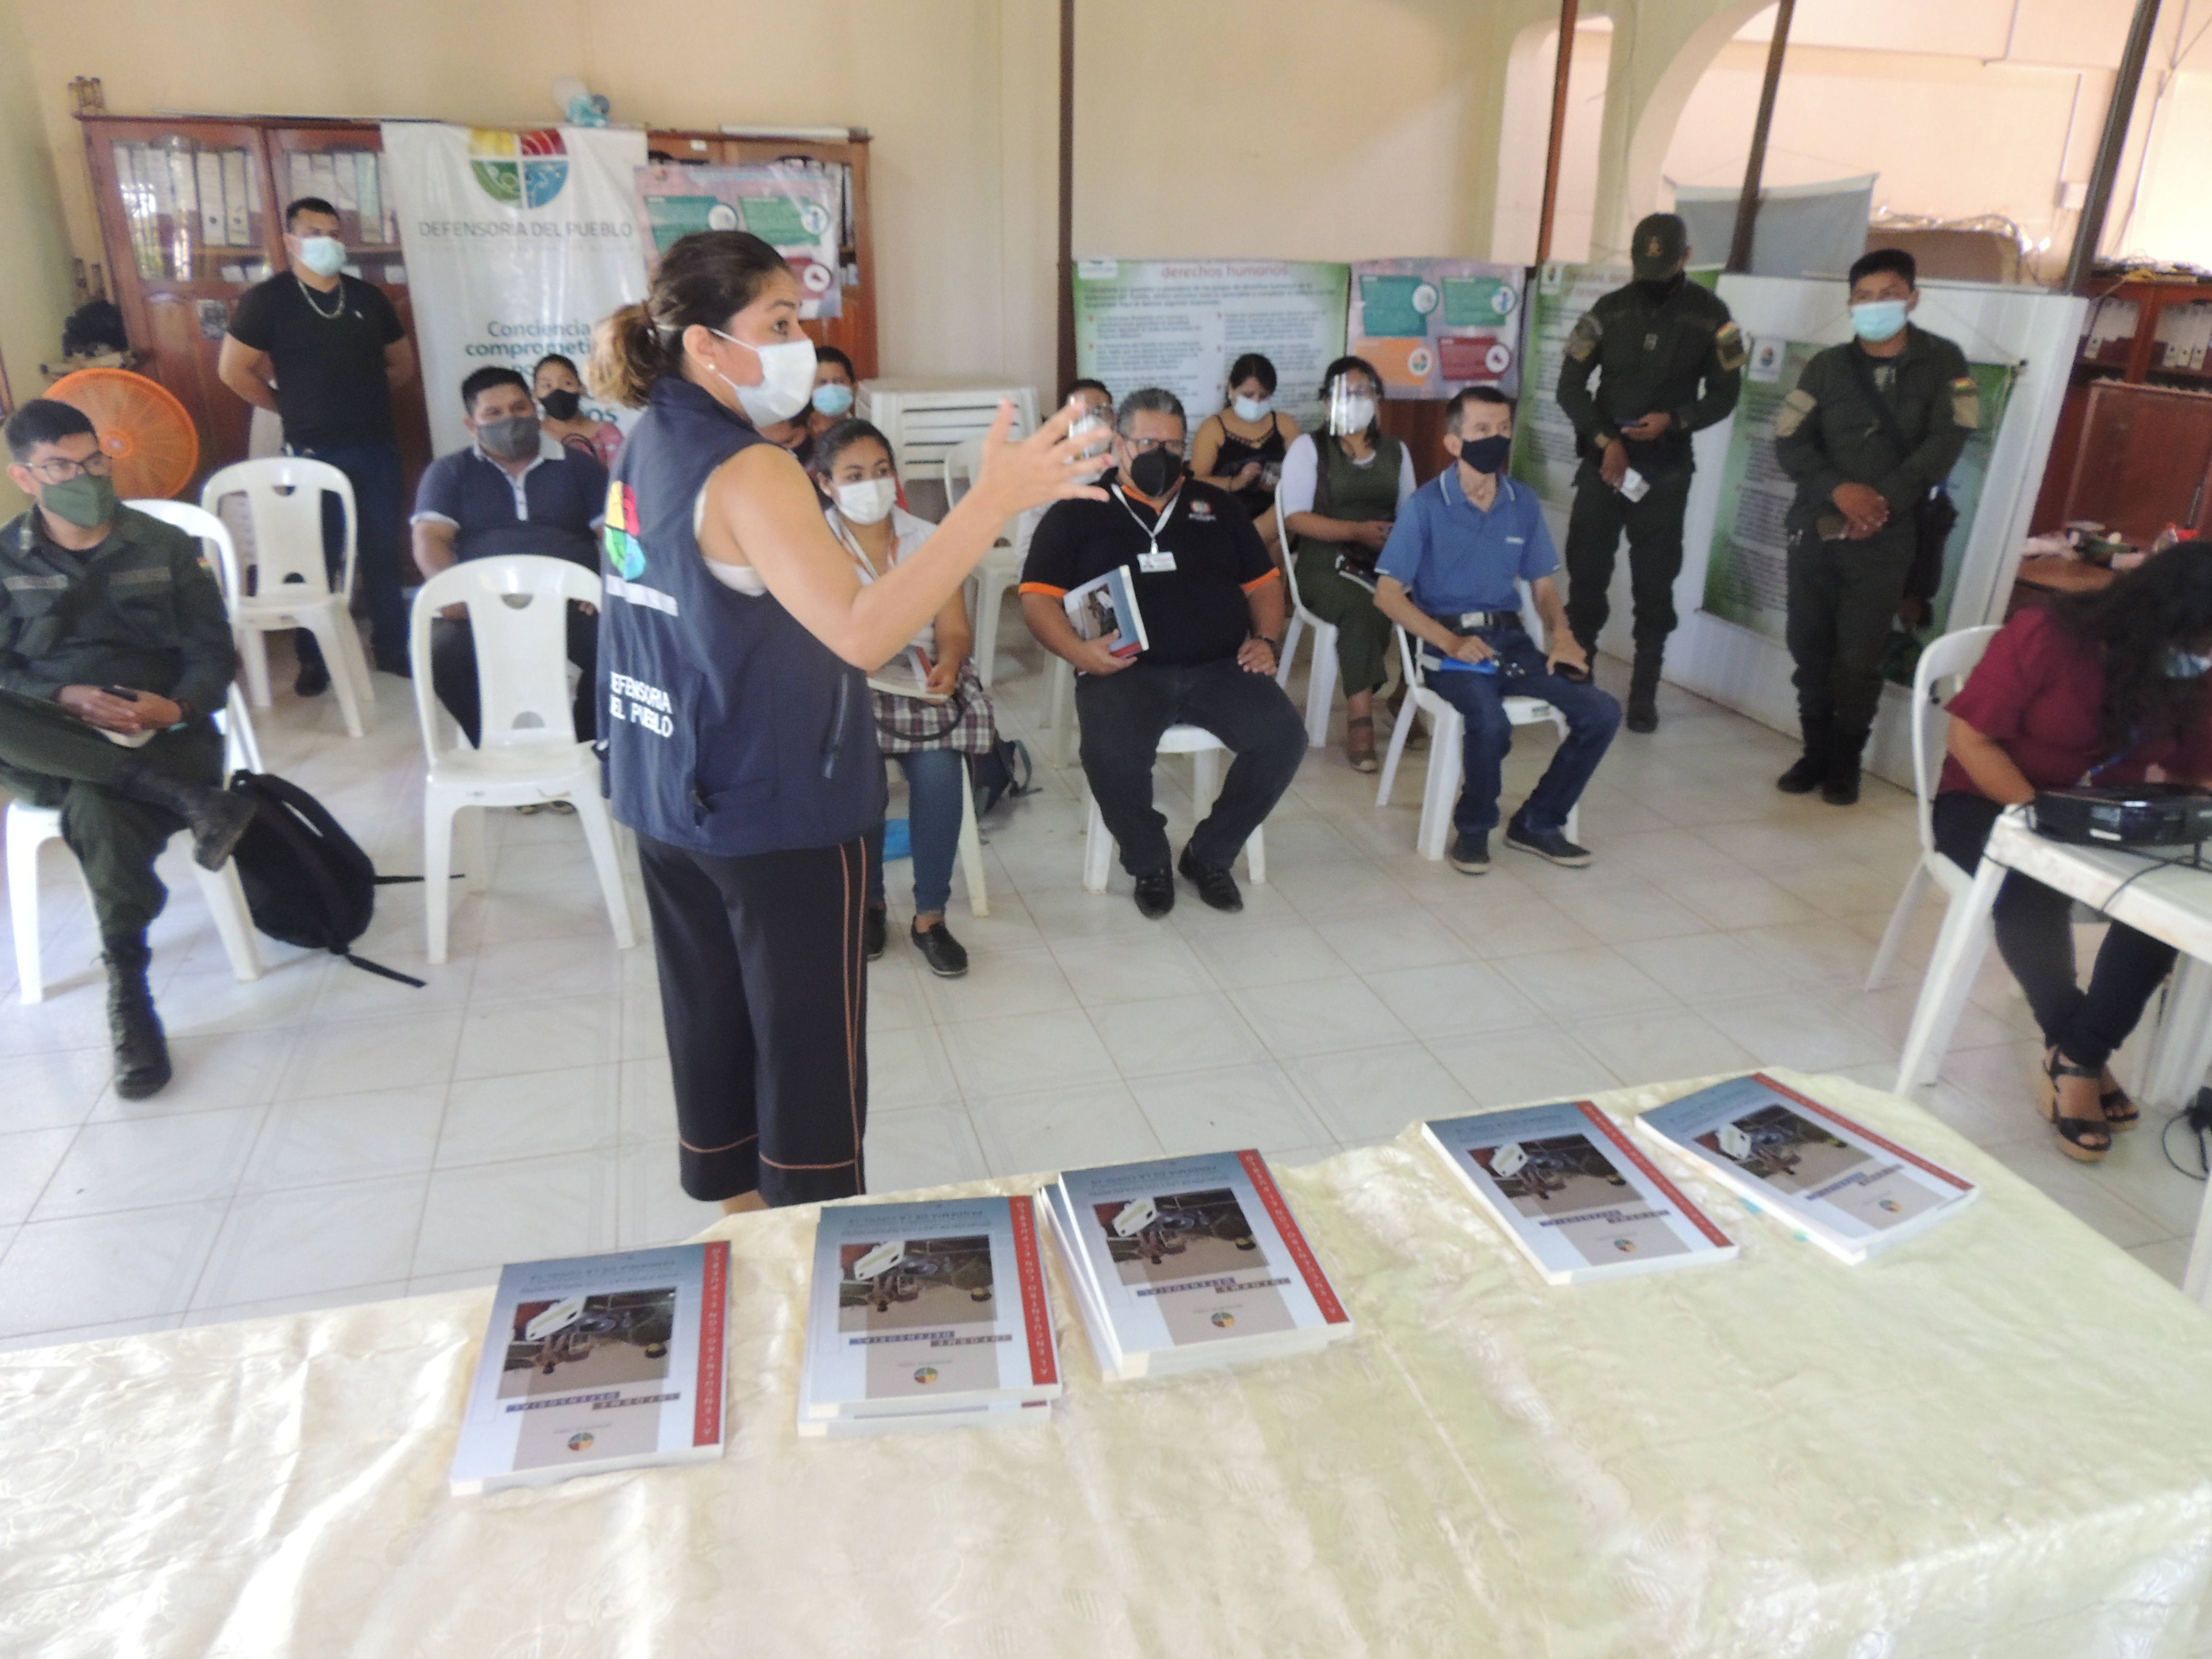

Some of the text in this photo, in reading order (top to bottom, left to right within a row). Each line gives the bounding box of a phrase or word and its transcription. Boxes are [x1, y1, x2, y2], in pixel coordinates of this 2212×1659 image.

[530, 221, 562, 237] DEL
[566, 221, 632, 238] PUEBLO
[1161, 263, 1288, 279] derechos humanos
[487, 320, 591, 337] Conciencia
[610, 670, 673, 714] EFENSORIA
[631, 702, 674, 738] PUEBLO
